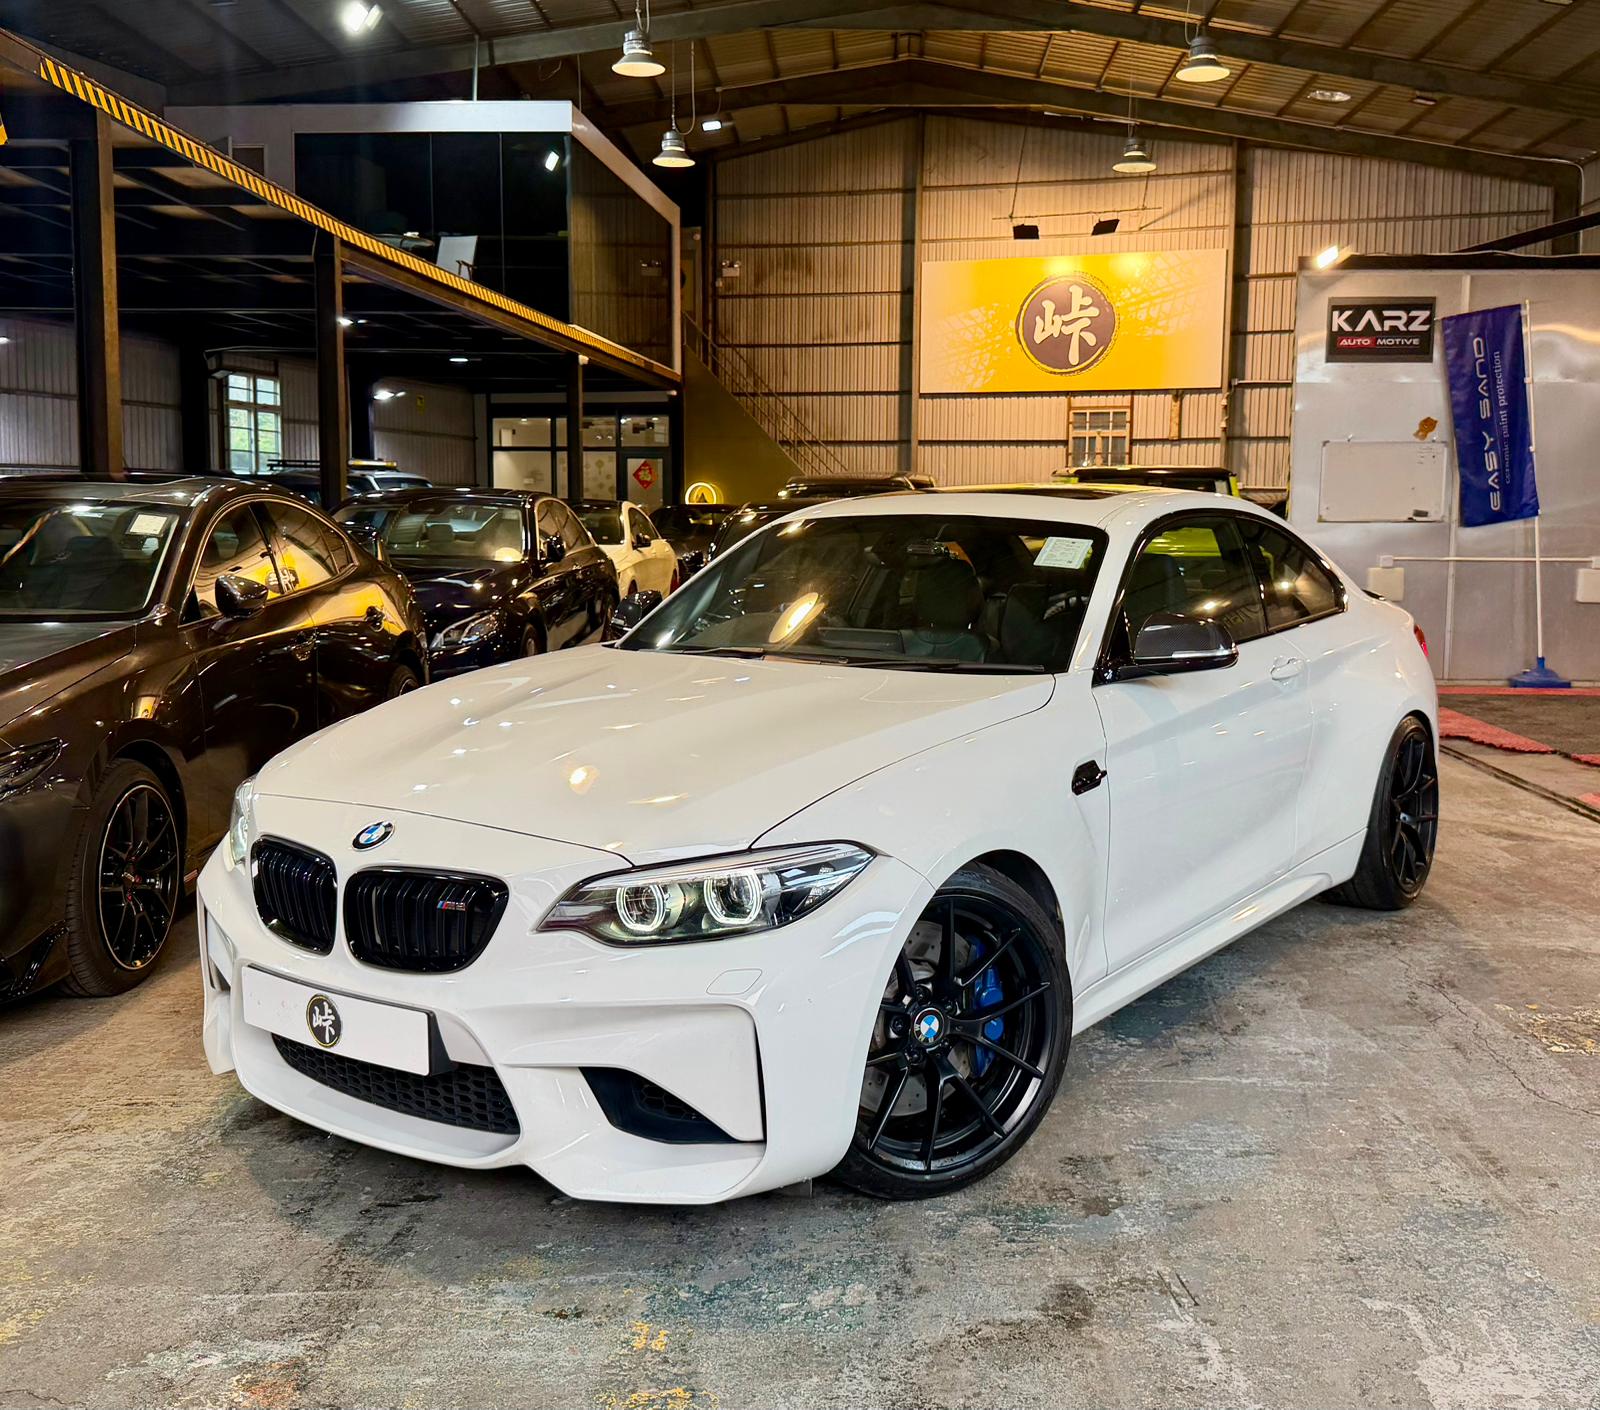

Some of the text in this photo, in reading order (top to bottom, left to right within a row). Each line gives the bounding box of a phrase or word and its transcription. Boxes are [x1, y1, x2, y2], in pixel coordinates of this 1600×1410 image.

[1033, 284, 1100, 366] 峠
[1331, 309, 1431, 332] KARZ
[1339, 338, 1420, 346] AUTO MOTIVE
[1493, 351, 1508, 407] protection
[1472, 337, 1501, 511] EASY SAND
[1498, 410, 1511, 438] paint
[312, 1001, 336, 1043] 峠
